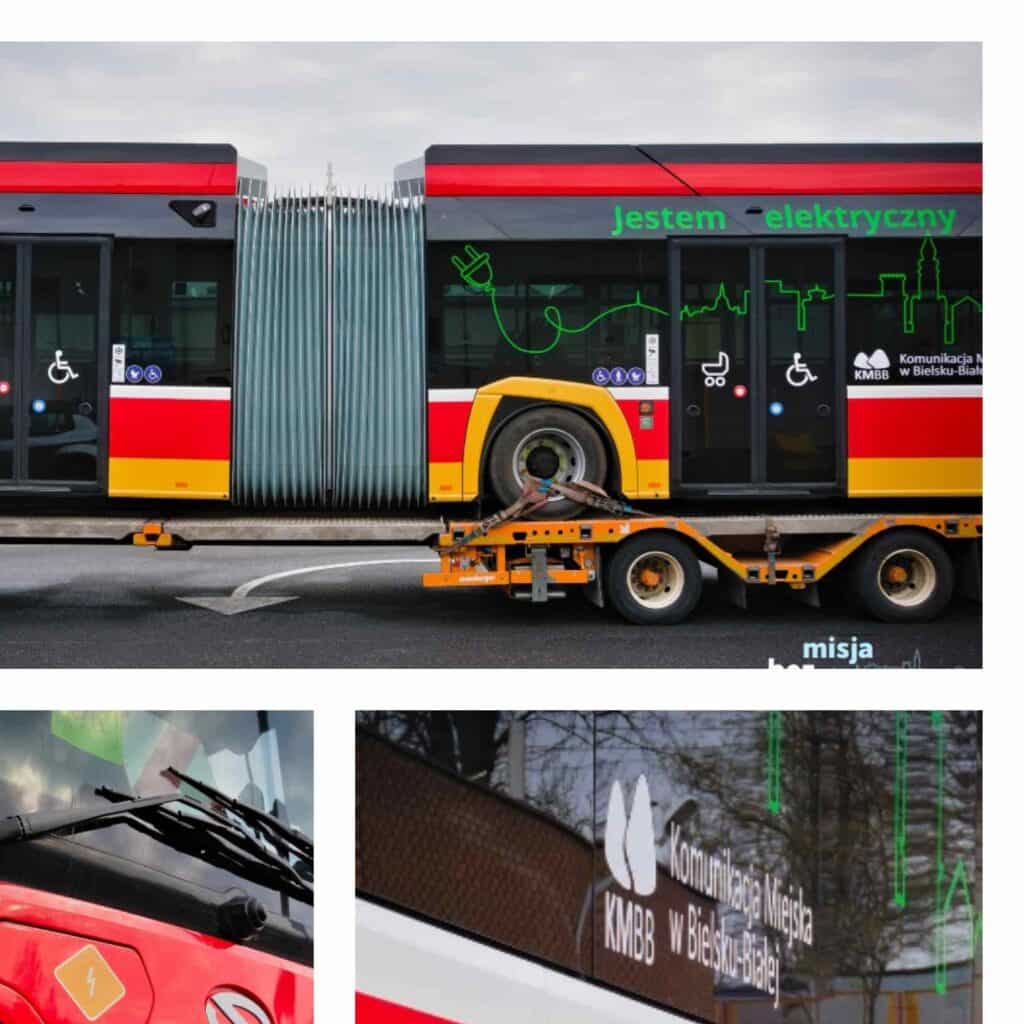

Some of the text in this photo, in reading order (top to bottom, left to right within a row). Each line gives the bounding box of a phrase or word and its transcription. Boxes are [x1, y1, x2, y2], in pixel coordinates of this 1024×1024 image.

[611, 203, 957, 237] Jestem elektryczny
[854, 369, 890, 380] KMBB
[899, 353, 973, 366] Komunikacja
[899, 367, 910, 376] w
[670, 821, 814, 948] Komunikacja Miejska
[604, 890, 656, 966] KMBB
[668, 903, 780, 1009] w Bielsku-Białej
